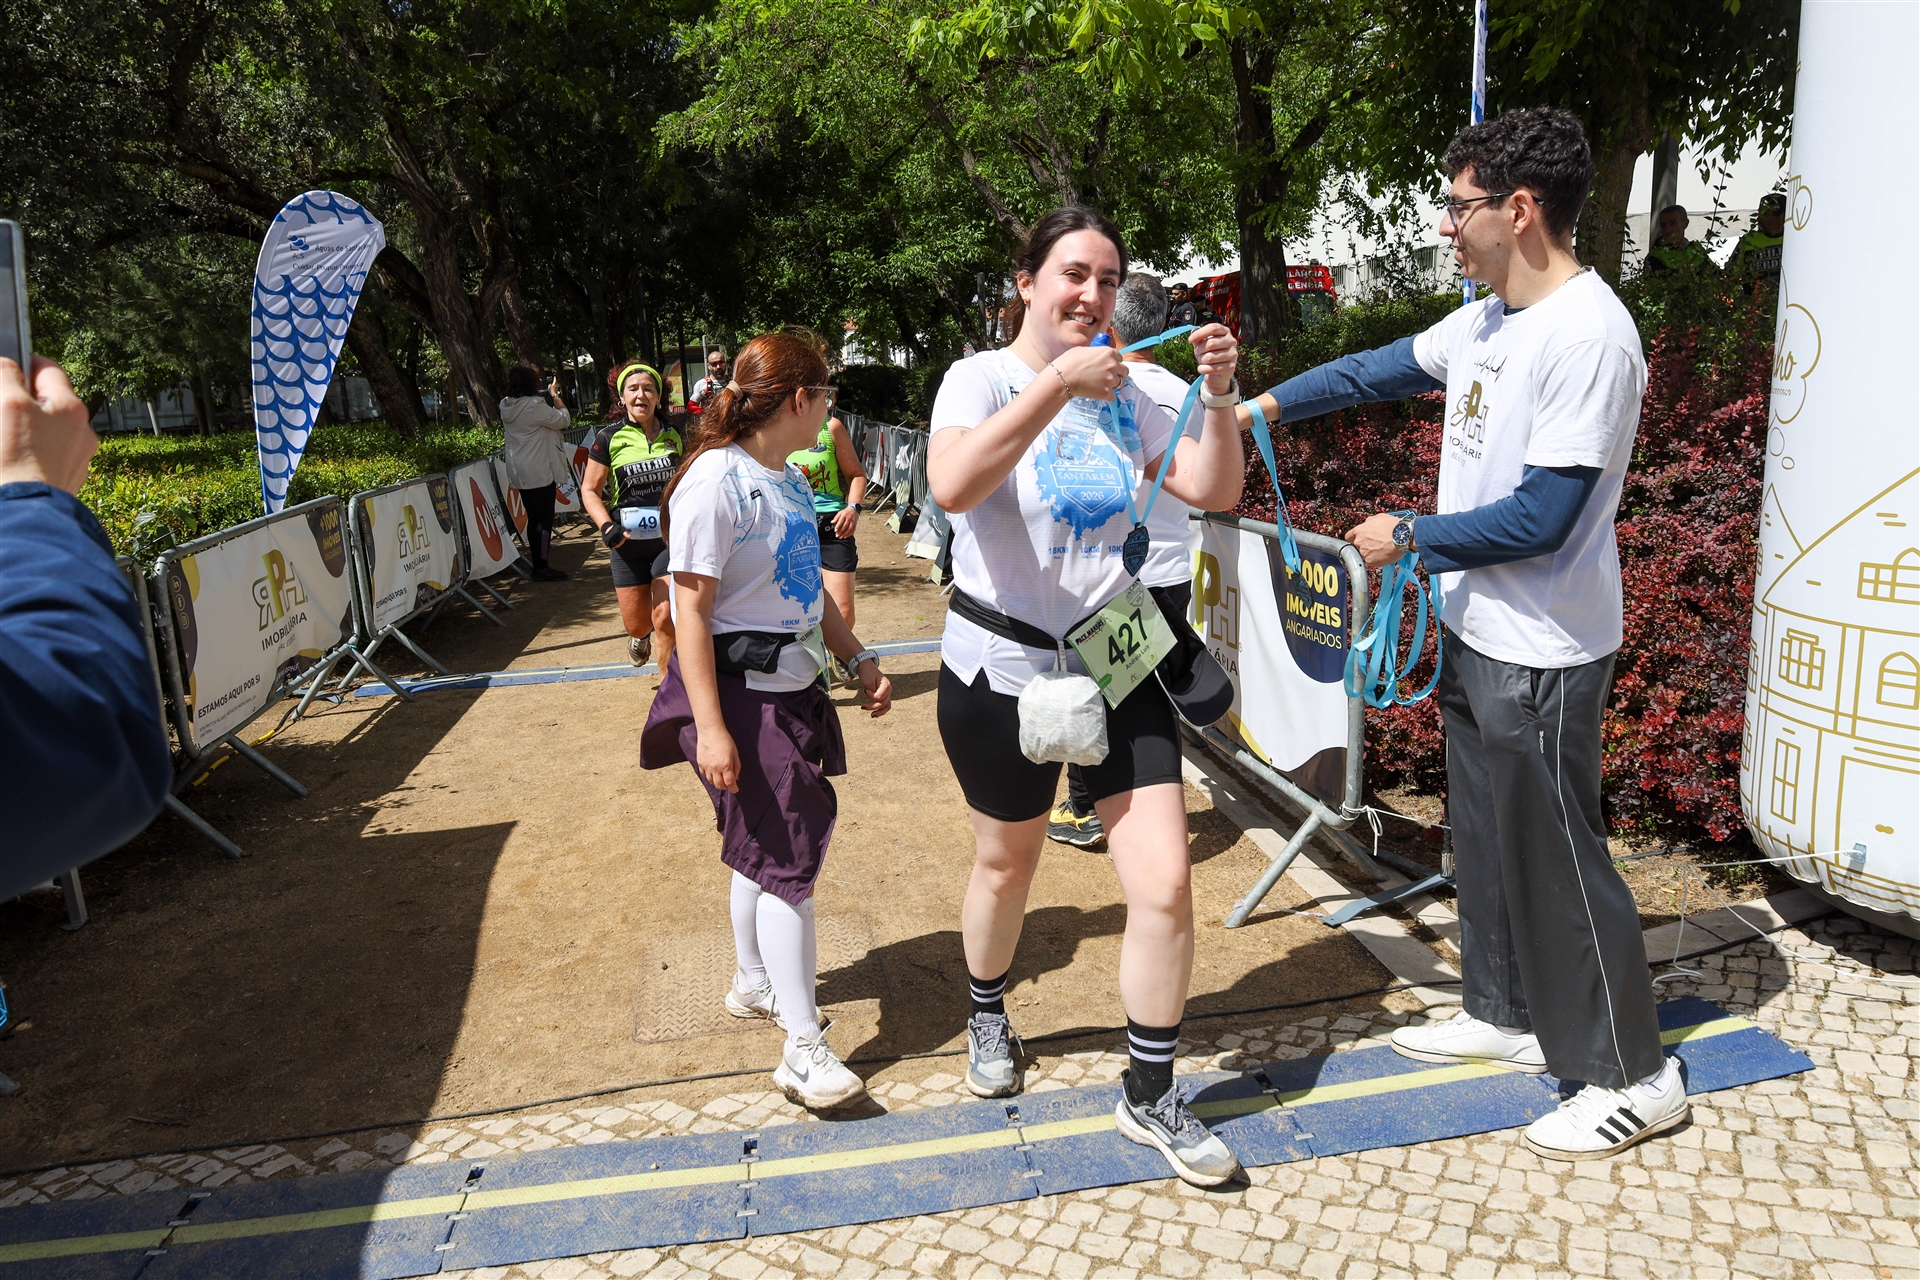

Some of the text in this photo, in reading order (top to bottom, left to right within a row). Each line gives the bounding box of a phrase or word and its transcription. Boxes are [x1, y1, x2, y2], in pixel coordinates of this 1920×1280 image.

[623, 456, 672, 476] TRILHO
[1057, 471, 1116, 480] SANTARÉM
[1080, 490, 1105, 500] 2026
[638, 515, 658, 530] 49
[1048, 545, 1123, 554] 18KM 10KM 10K
[1285, 559, 1339, 597] +000
[1108, 607, 1148, 667] 427
[1286, 618, 1342, 649] ANGARIADOS
[198, 694, 228, 719] ESTAMOS
[228, 684, 243, 702] AQUI
[243, 678, 256, 692] POR
[255, 673, 261, 685] SI
